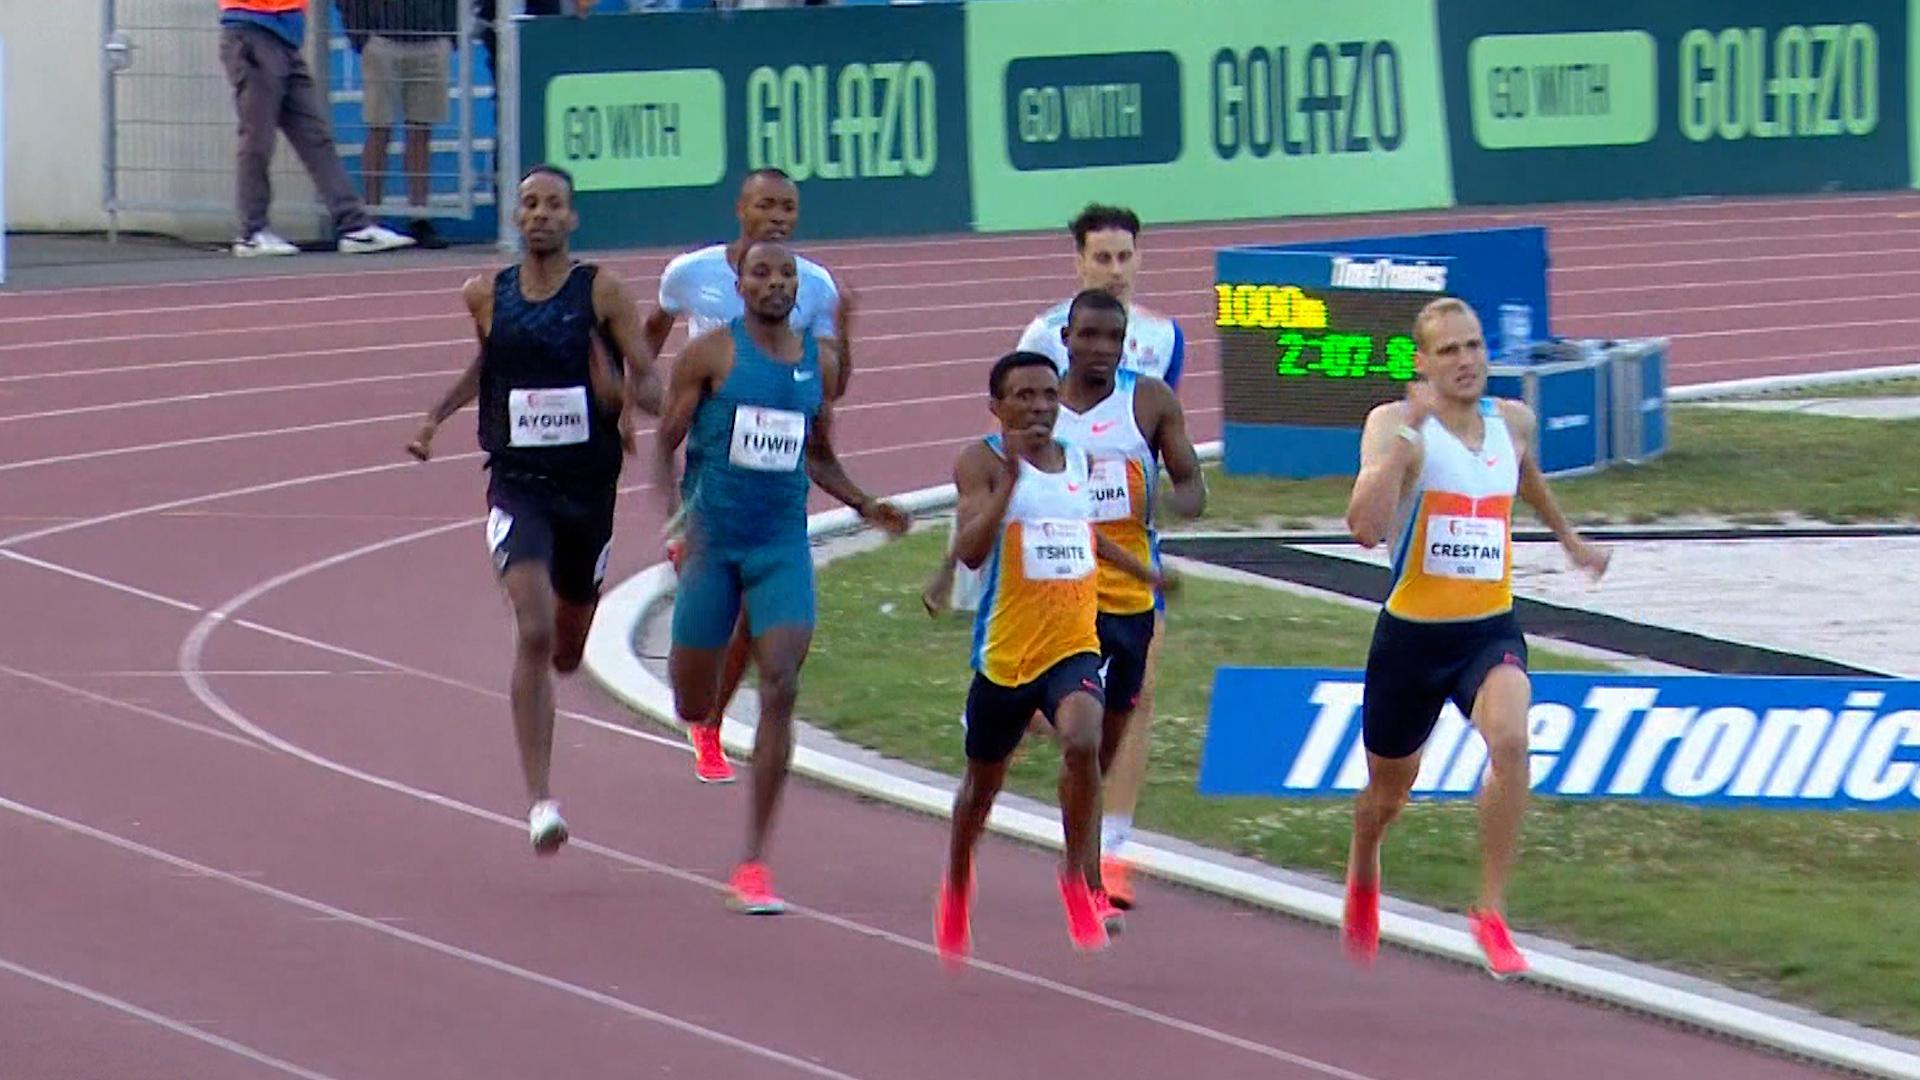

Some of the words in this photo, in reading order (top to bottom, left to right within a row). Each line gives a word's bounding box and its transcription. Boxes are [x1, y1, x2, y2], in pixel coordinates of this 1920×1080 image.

[1214, 38, 1403, 159] GOLAZO
[1489, 66, 1529, 118] GO
[1531, 63, 1611, 116] WITH
[1679, 22, 1878, 141] GOLAZO
[564, 105, 600, 160] GO
[606, 102, 681, 159] WITH
[747, 61, 937, 182] GOLAZO
[1018, 87, 1062, 142] GO
[1063, 83, 1142, 139] WITH
[518, 413, 581, 428] AYOUNI
[743, 433, 799, 454] TUWEI
[1035, 545, 1085, 560] TSHITE
[1430, 542, 1501, 560] CRESTAN
[1282, 680, 1920, 801] TmeTronic
